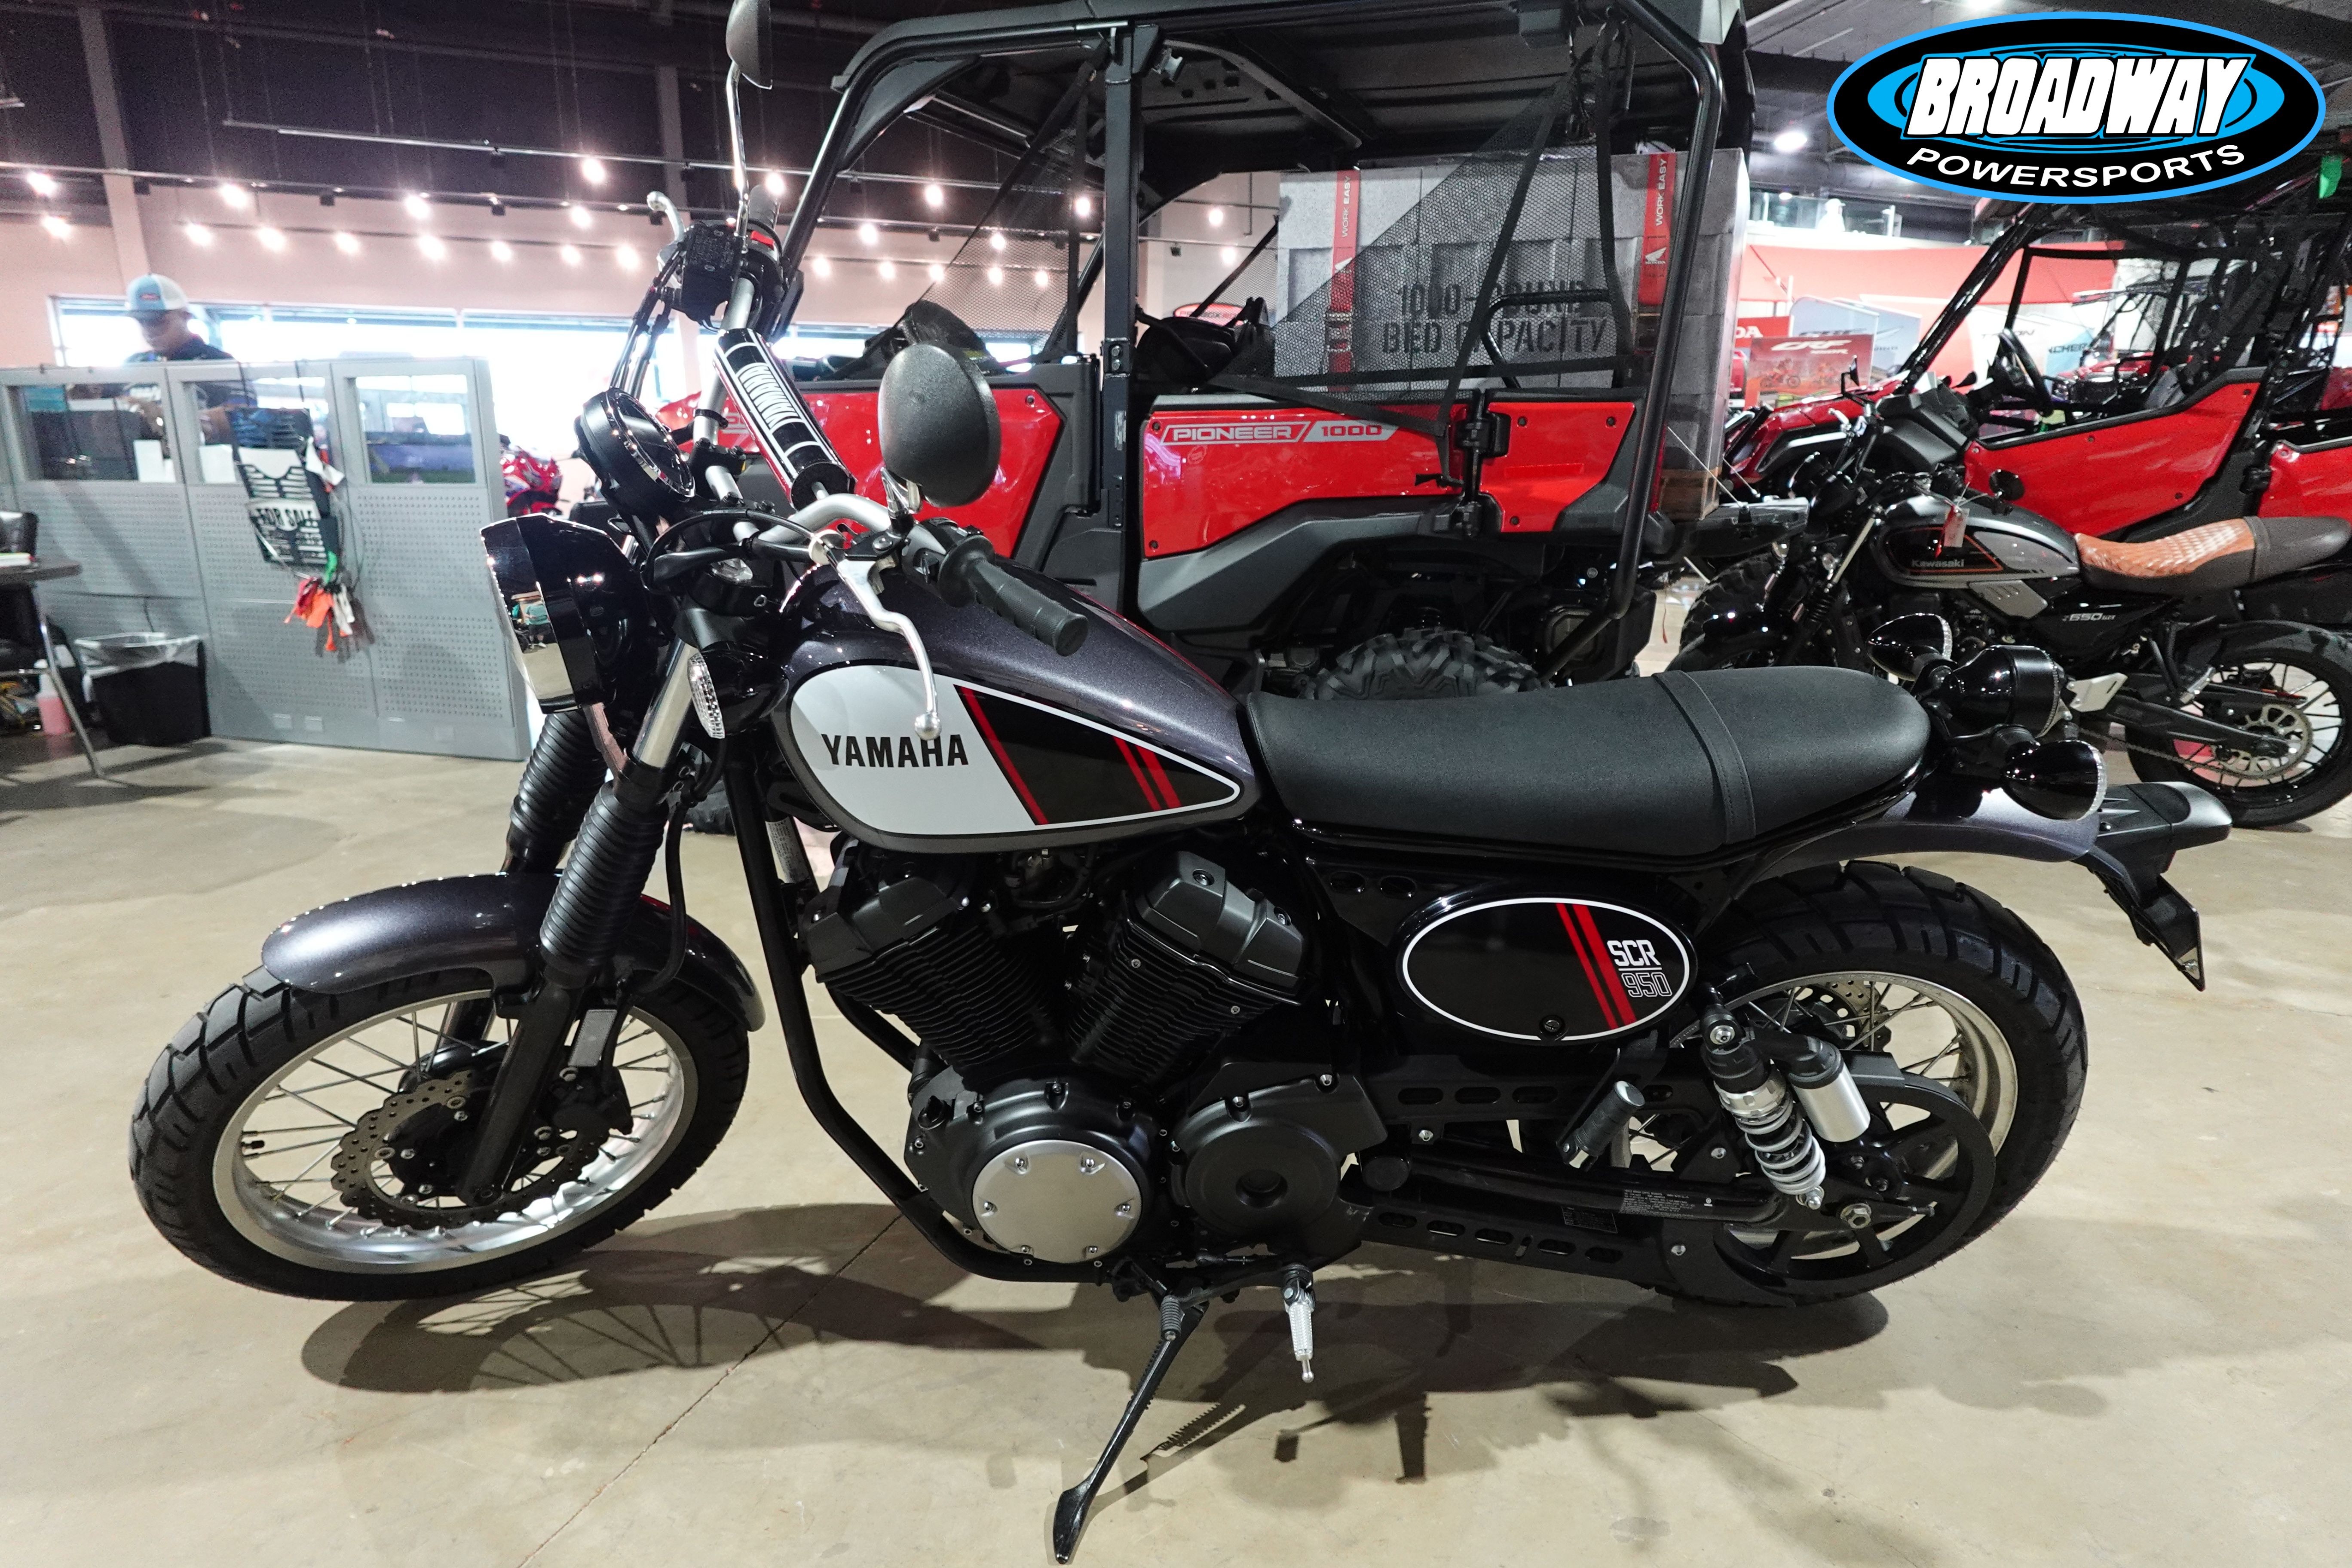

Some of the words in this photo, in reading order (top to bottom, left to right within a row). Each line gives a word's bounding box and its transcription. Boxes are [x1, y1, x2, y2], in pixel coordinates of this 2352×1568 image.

[1659, 159, 1667, 190] EASY
[1656, 193, 1664, 226] WORK
[1382, 322, 1441, 352] BED
[1770, 340, 1852, 351] CRF
[738, 365, 800, 429] YAMAHA
[1173, 426, 1292, 441] PIONEER
[1321, 425, 1383, 436] 1000
[1912, 559, 1964, 567] Kawasaki
[821, 734, 969, 768] YAMAHA
[1607, 940, 1660, 966] SCR
[1621, 972, 1673, 998] 950
